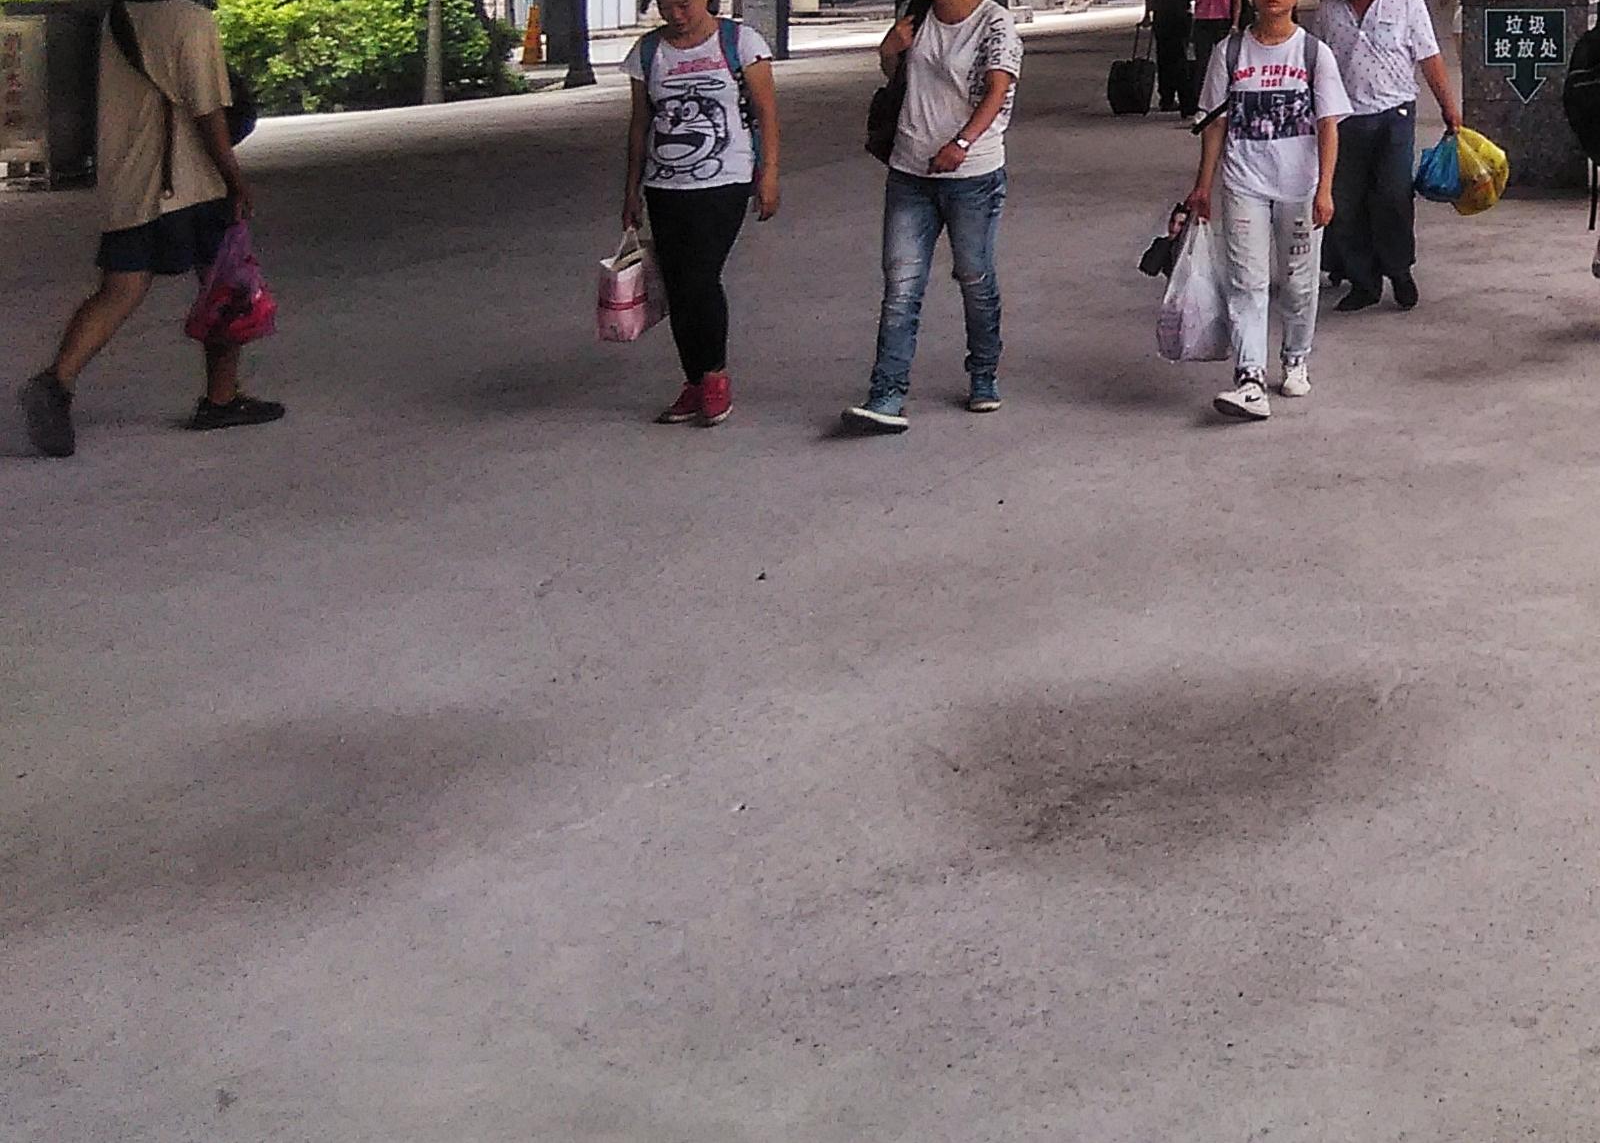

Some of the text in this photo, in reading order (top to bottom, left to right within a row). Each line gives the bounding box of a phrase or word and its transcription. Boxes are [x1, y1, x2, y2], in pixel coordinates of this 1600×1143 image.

[1506, 15, 1546, 34] 垃圾
[1494, 38, 1557, 58] 投放处
